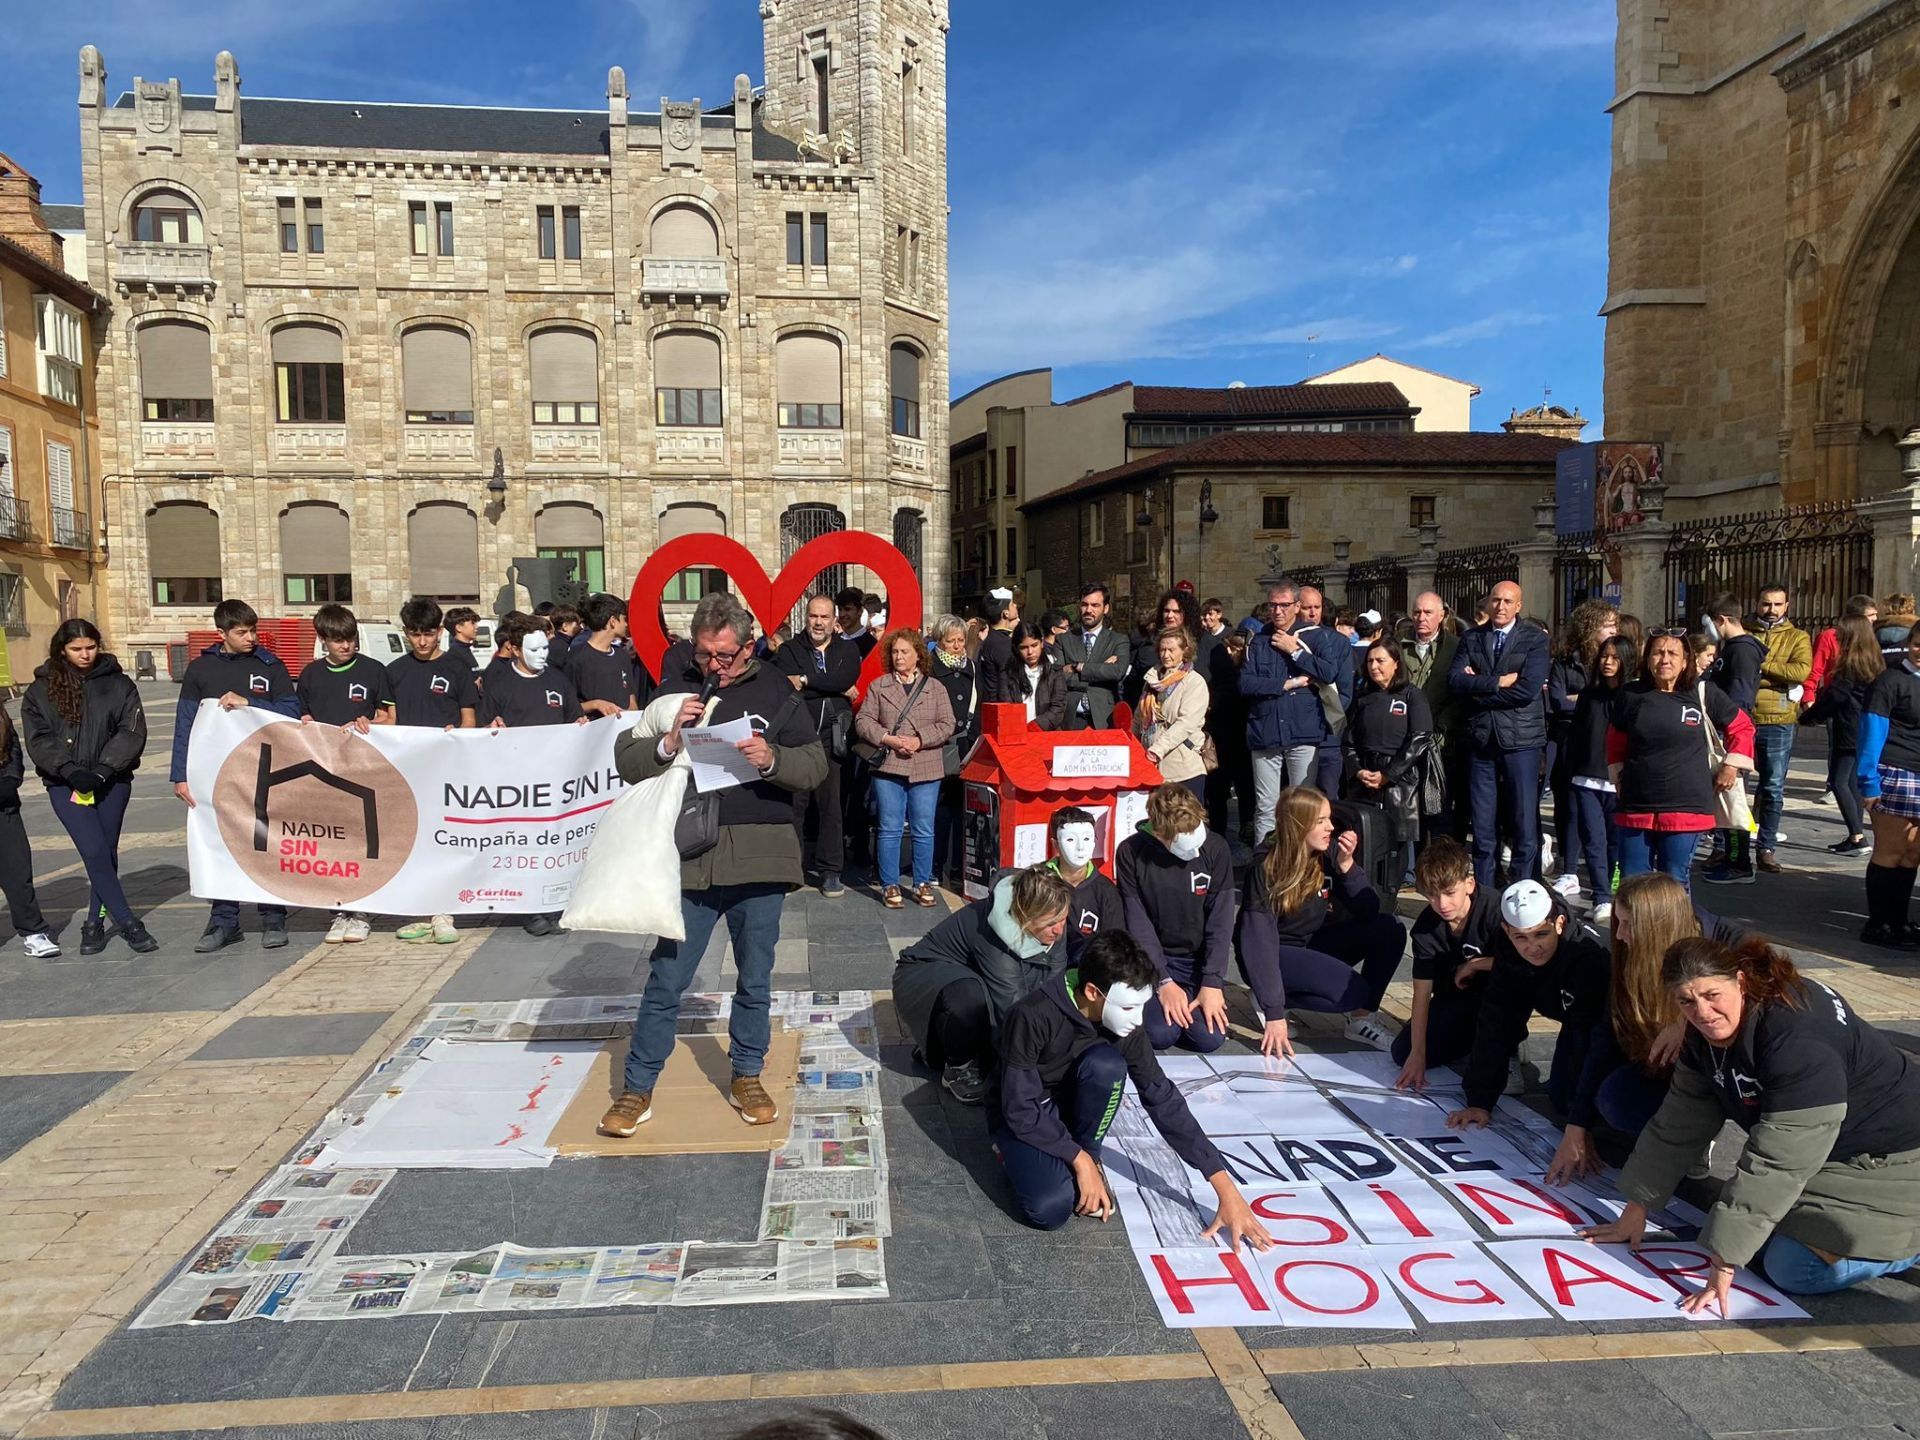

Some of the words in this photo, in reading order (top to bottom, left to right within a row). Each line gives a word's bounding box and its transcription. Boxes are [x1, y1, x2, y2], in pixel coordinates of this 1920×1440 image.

[1602, 584, 1622, 597] MU
[1079, 747, 1108, 757] ACCESO
[1091, 756, 1100, 764] LA
[444, 783, 551, 809] NADIE
[561, 771, 598, 804] SIN
[282, 821, 346, 840] NADIE
[279, 839, 318, 857] SIN
[434, 829, 528, 852] Campaña
[536, 830, 560, 845] de
[279, 858, 360, 878] HOGAR
[492, 856, 513, 869] 23
[517, 856, 538, 869] DE
[1150, 1248, 1780, 1316] HOGAR
